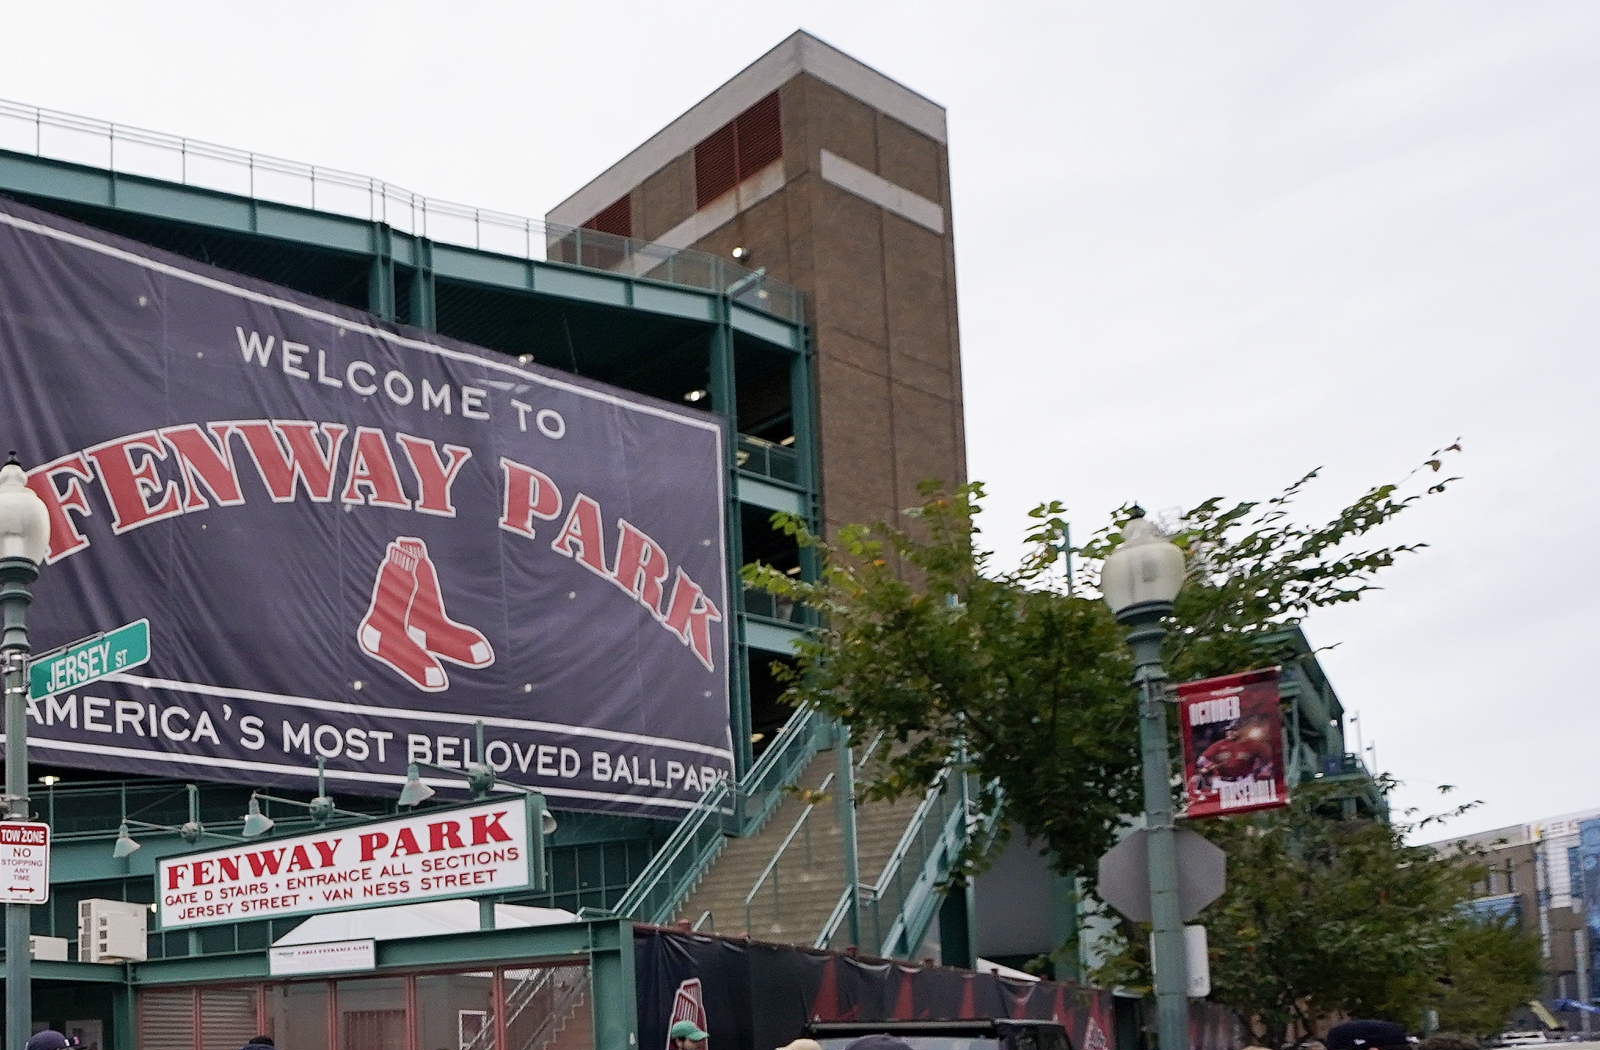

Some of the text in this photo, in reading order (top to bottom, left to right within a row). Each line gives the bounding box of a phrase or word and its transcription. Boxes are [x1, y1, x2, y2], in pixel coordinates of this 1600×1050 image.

[236, 326, 567, 440] WELCOME TO
[26, 419, 723, 672] FENWAY PARK
[46, 641, 129, 693] JERSEY ST
[26, 694, 733, 796] AMERICA'S MOST BELOVED BALLPARK
[1, 829, 45, 844] TOW ZONE
[1, 859, 43, 867] STOPPING
[13, 847, 31, 858] NO
[167, 811, 514, 890] FENWAY PARK
[164, 847, 520, 907] GATE D STAIRS ENTRANCE ALL SECTIONS
[178, 868, 498, 920] JERSEY STREET VAN NESS STREET
